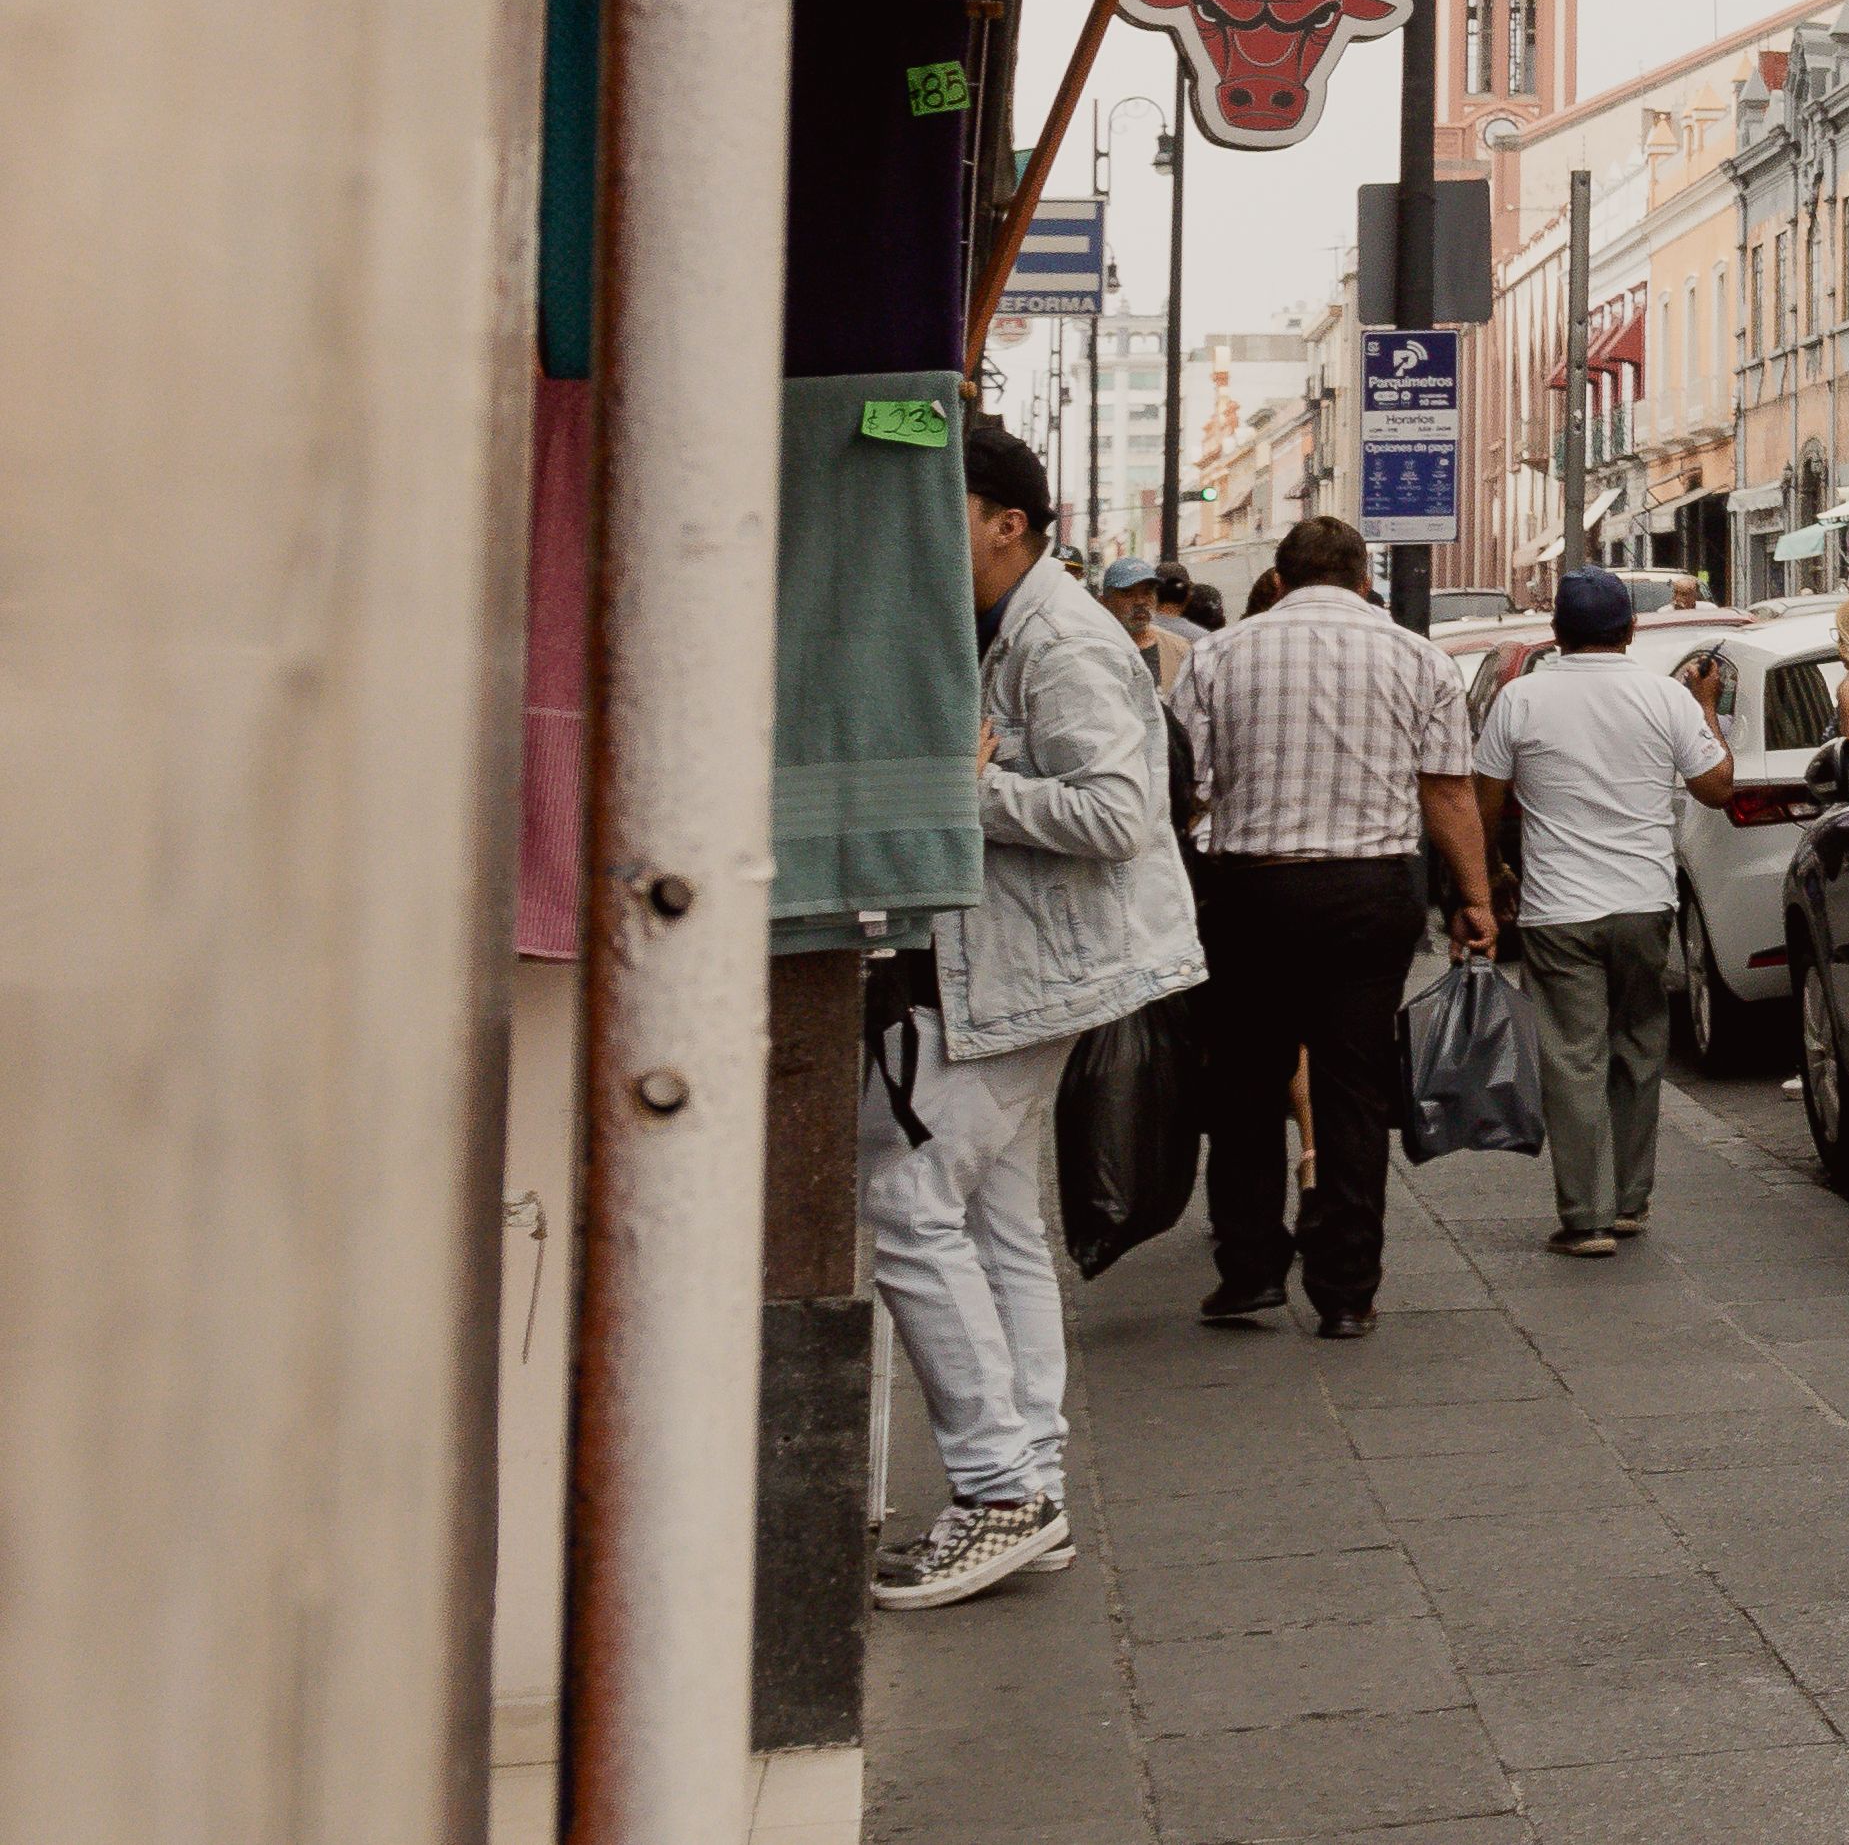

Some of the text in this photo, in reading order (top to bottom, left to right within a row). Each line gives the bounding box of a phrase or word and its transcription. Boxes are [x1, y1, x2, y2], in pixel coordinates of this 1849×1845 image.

[999, 296, 1096, 313] EFORMA
[1385, 414, 1435, 424] Horarios
[1365, 443, 1412, 454] Opciones
[1428, 444, 1454, 454] pago
